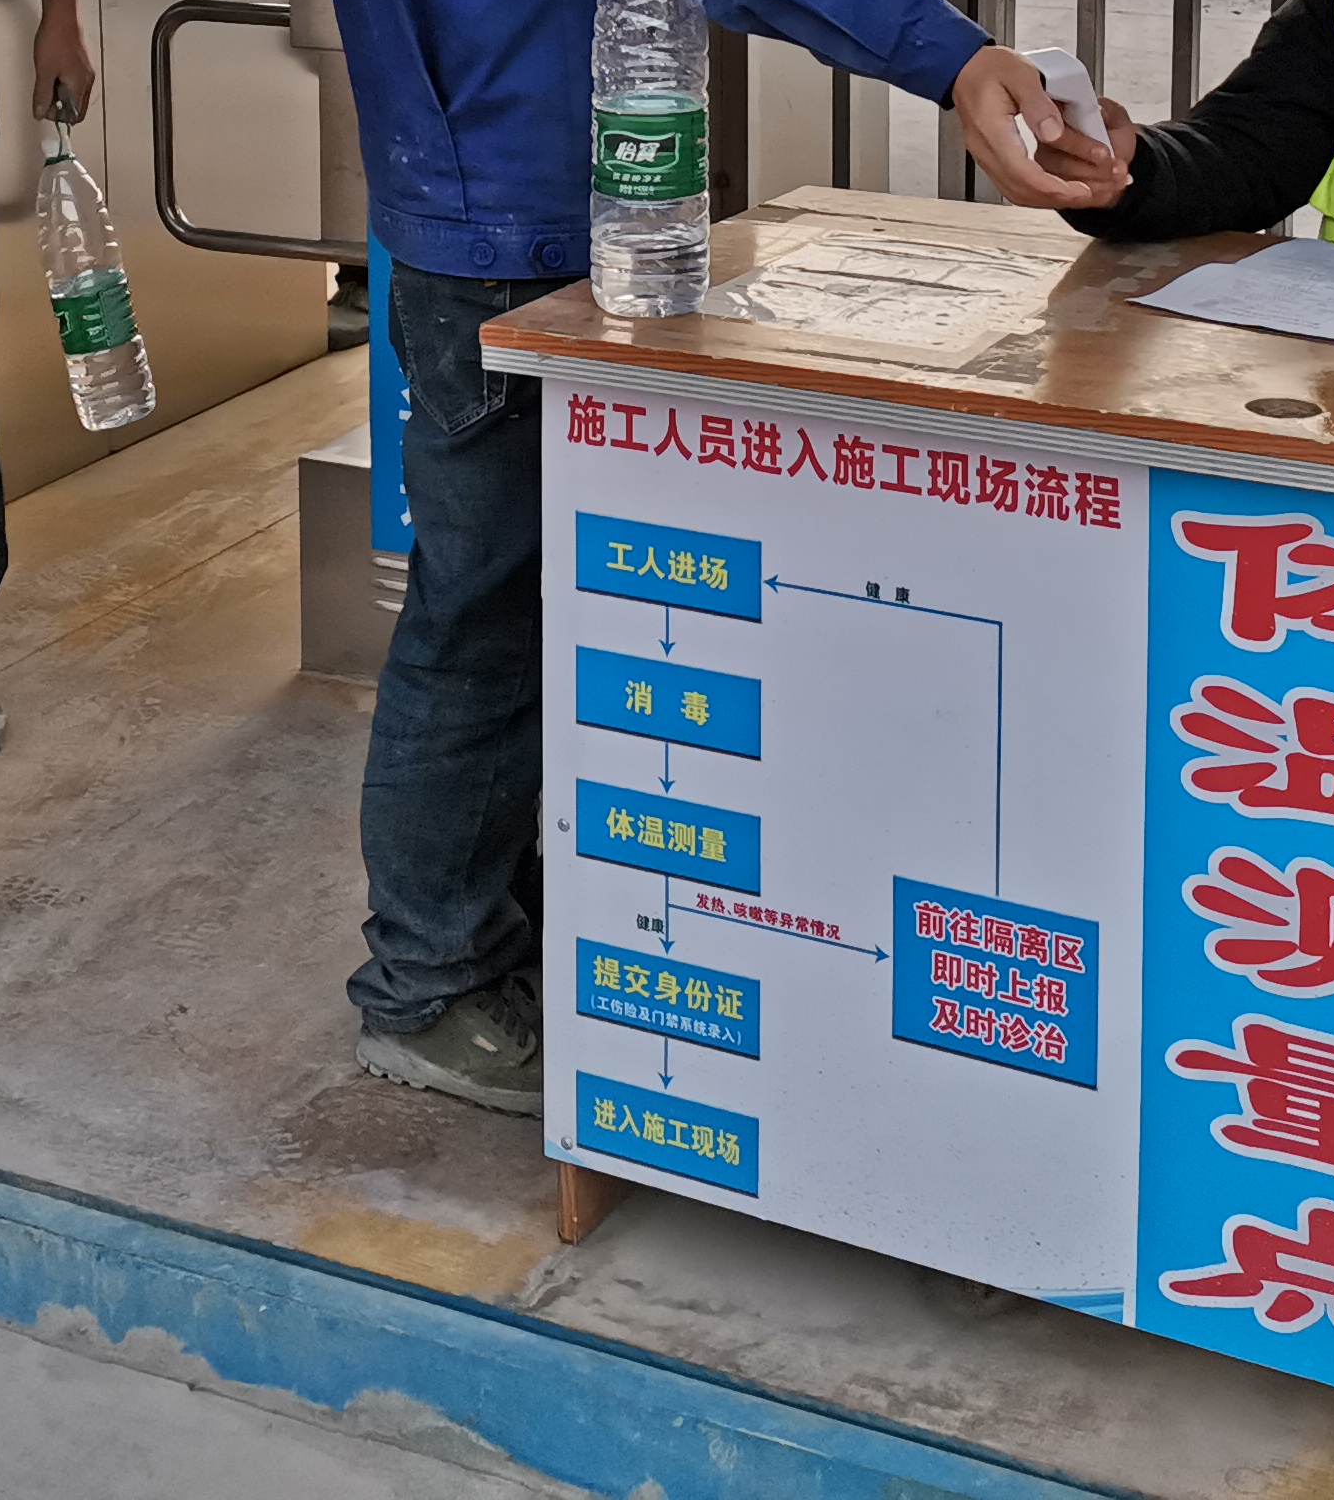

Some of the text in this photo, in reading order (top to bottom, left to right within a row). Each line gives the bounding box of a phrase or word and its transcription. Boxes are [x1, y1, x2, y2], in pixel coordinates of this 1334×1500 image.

[567, 394, 1123, 530] 施工人员进入施工现场流程
[606, 541, 729, 591] 工人进场
[625, 680, 710, 727] 消毒
[606, 807, 728, 863] 体温测量
[636, 914, 665, 934] 健康
[695, 893, 842, 941] 发热、咳嗽等异常情况
[913, 901, 1086, 974] 前往隔离区
[593, 955, 745, 1022] 提交身份证
[931, 951, 1068, 1017] 即时上报
[930, 997, 1068, 1064] 及时诊治
[593, 1096, 742, 1167] 进入施工现场
